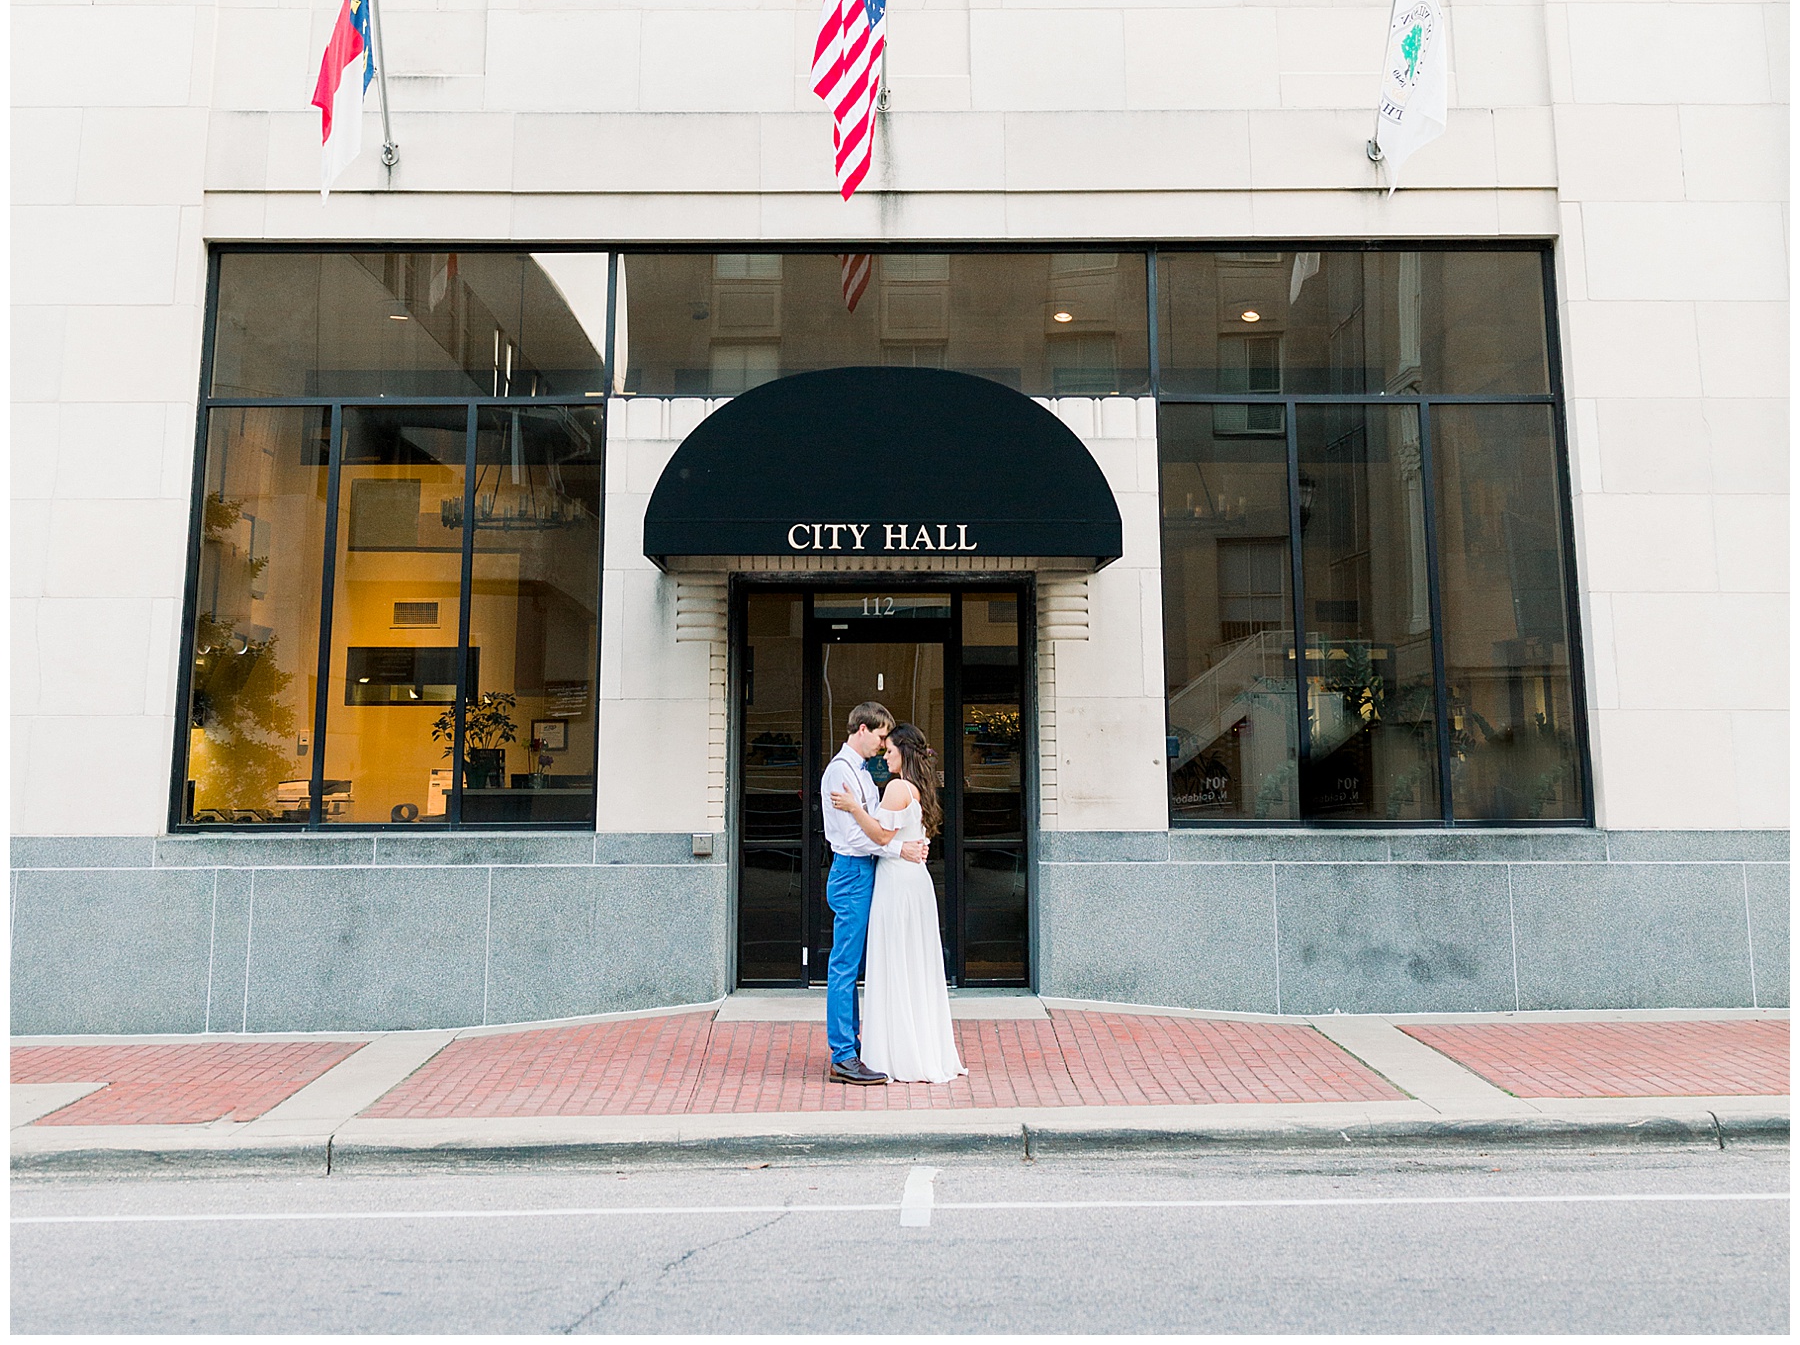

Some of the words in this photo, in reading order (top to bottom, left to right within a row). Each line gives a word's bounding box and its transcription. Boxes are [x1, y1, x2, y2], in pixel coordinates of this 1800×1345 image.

[787, 523, 870, 550] CITY
[882, 524, 977, 551] HALL
[861, 597, 895, 616] 112
